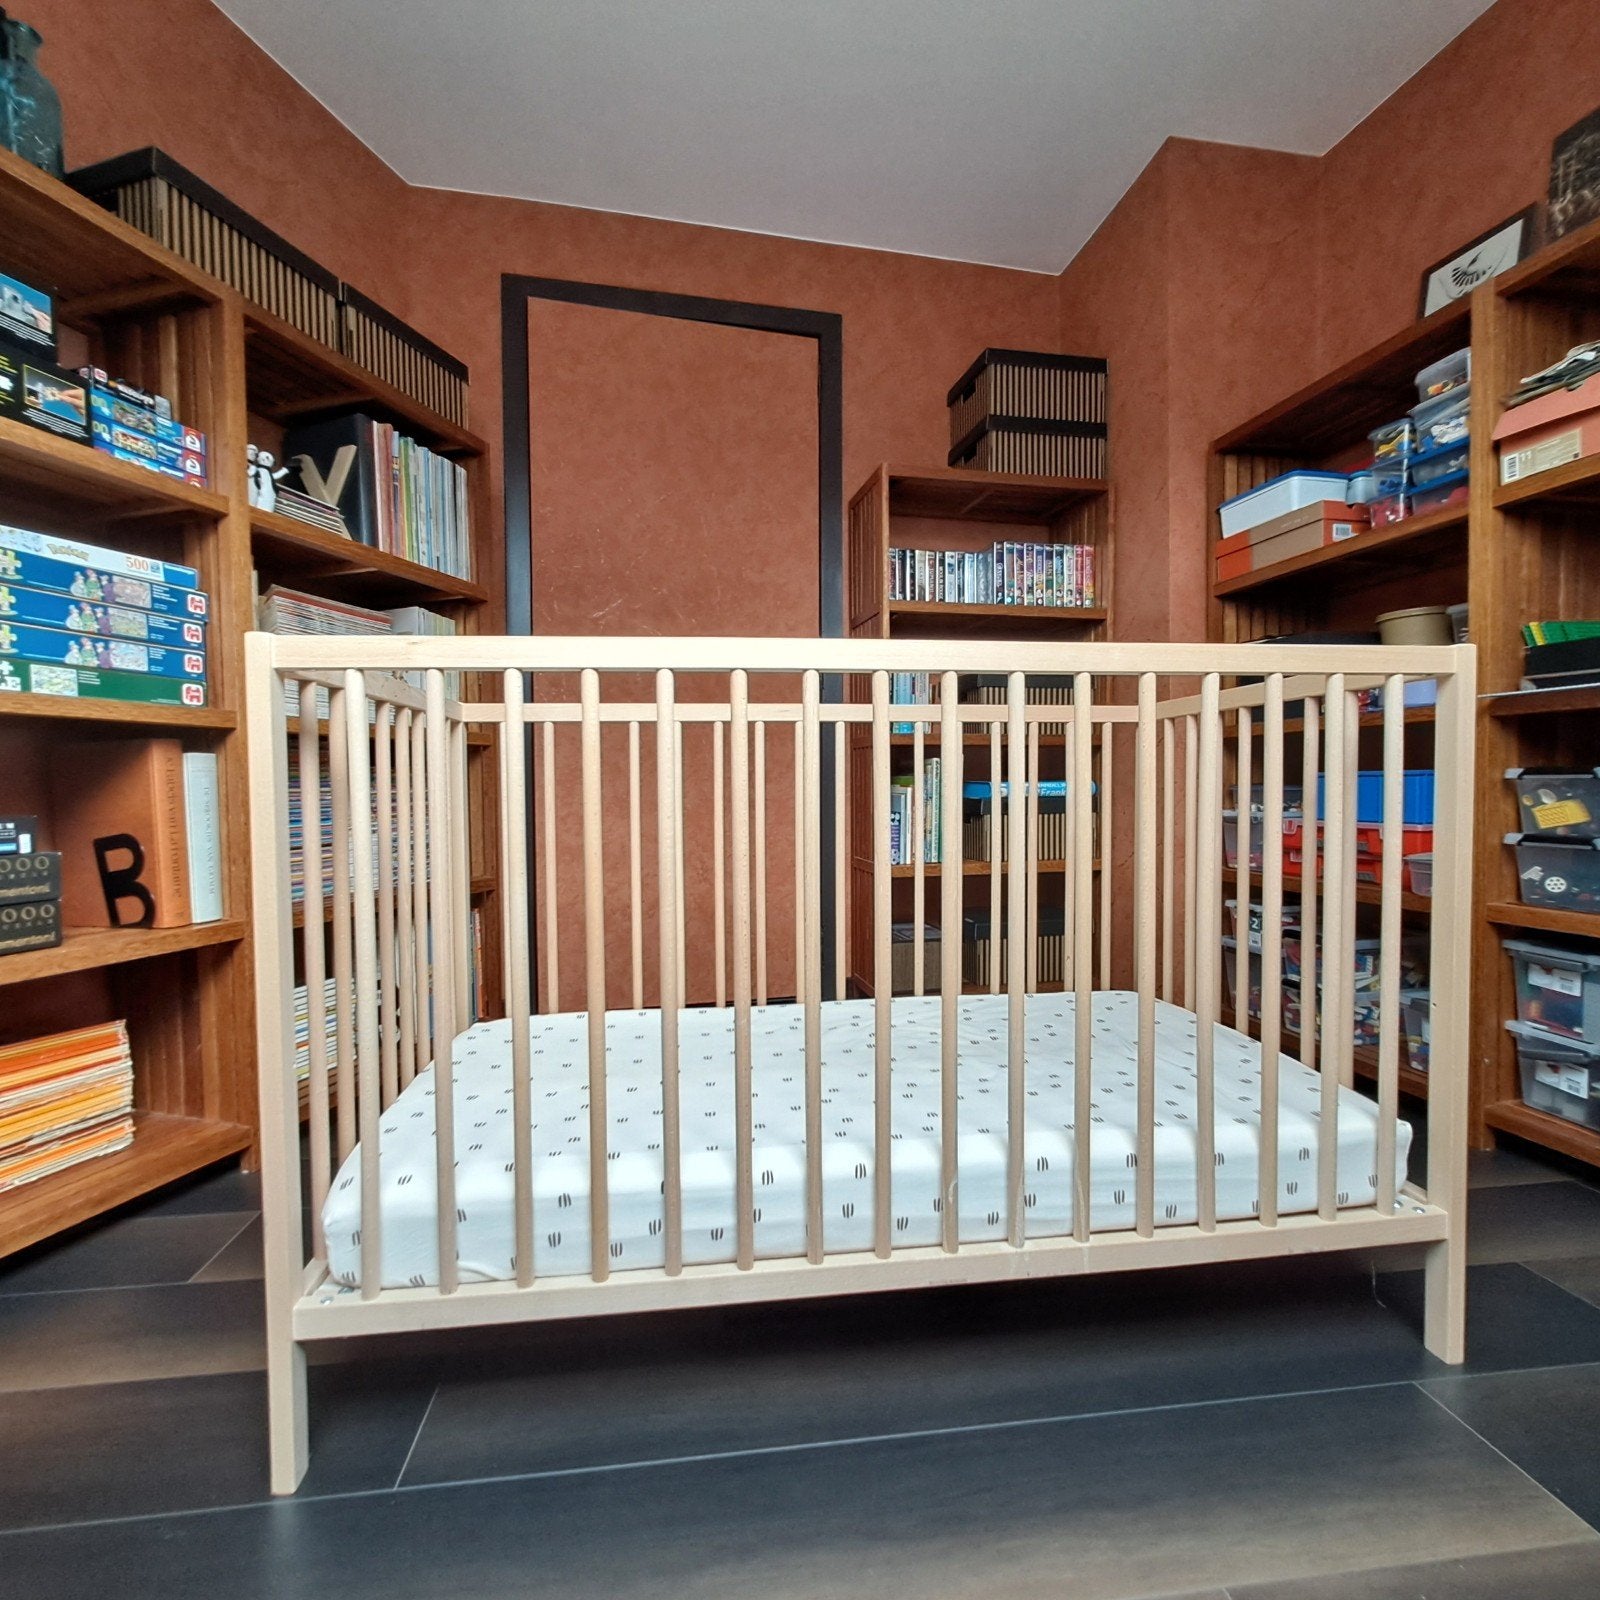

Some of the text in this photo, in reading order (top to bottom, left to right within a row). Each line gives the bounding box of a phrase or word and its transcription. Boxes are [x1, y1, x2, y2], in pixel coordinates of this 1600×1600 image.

[126, 556, 149, 572] 500
[93, 833, 156, 929] B
[1251, 917, 1259, 929] 2
